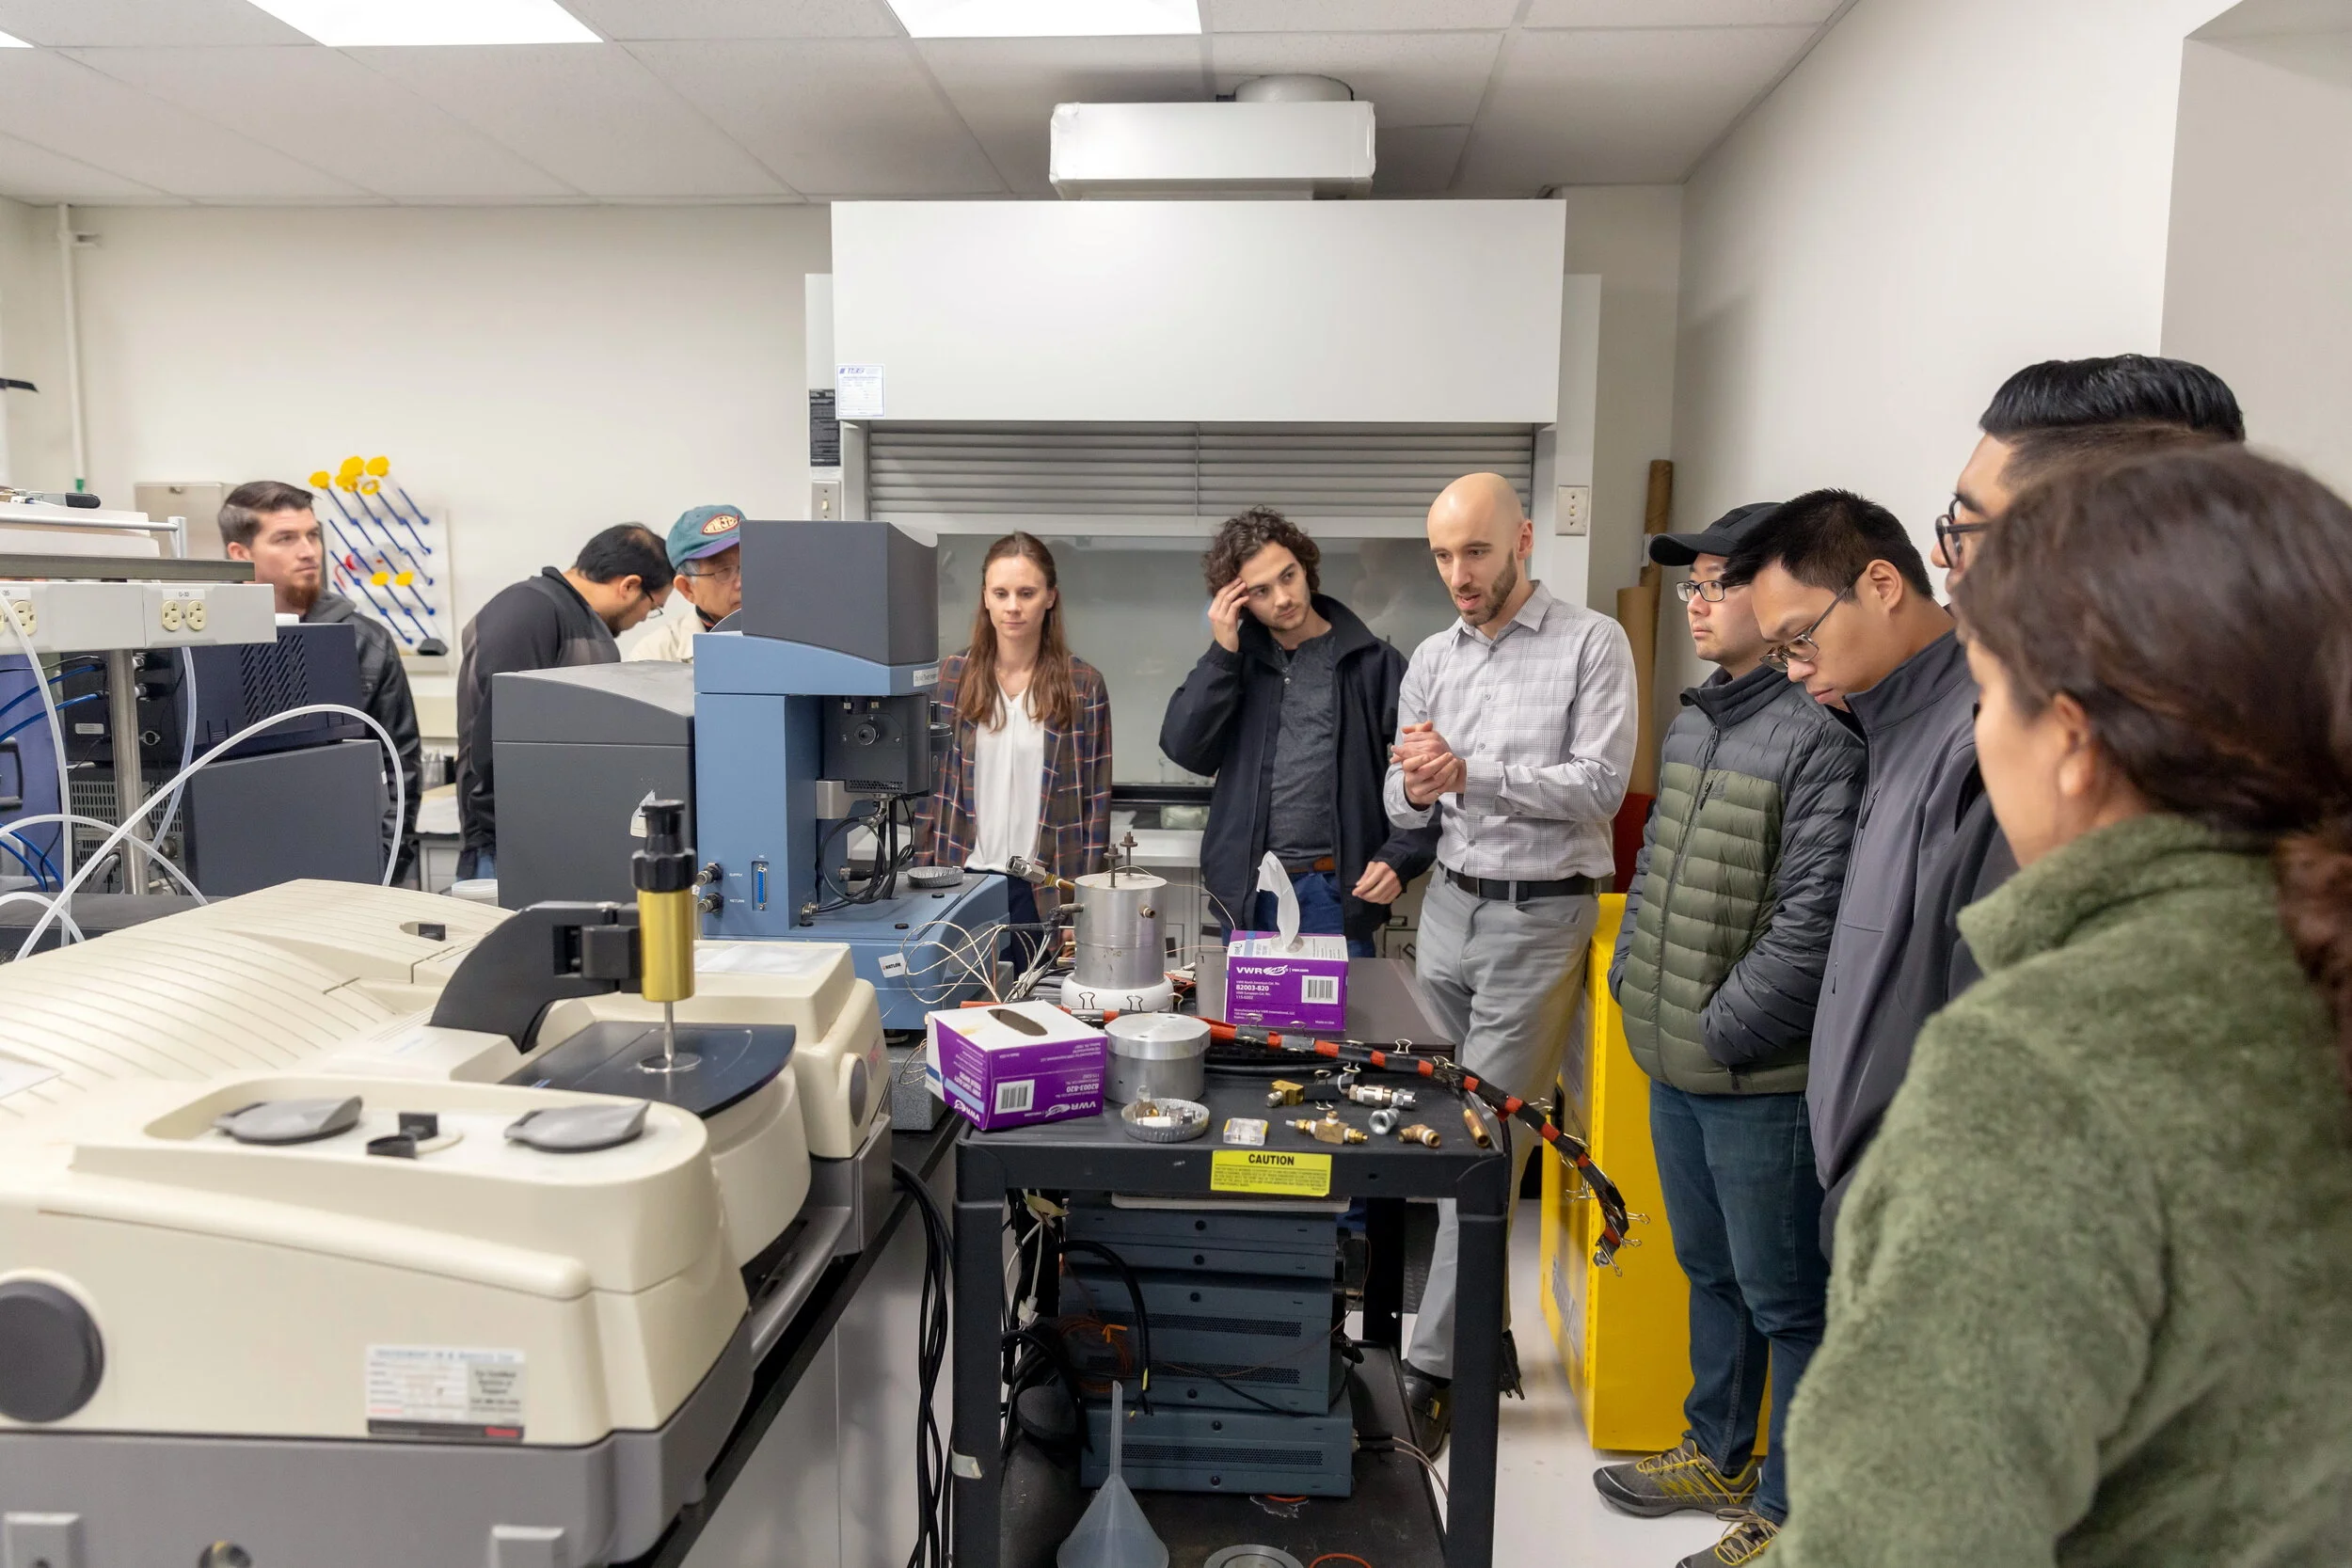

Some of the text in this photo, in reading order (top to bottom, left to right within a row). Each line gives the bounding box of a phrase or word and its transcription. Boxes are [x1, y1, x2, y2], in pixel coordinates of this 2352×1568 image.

[1236, 966, 1262, 974] VWR
[1067, 1083, 1099, 1093] 82003-820
[1072, 1101, 1096, 1110] VWR
[1248, 1153, 1295, 1165] CAUTION
